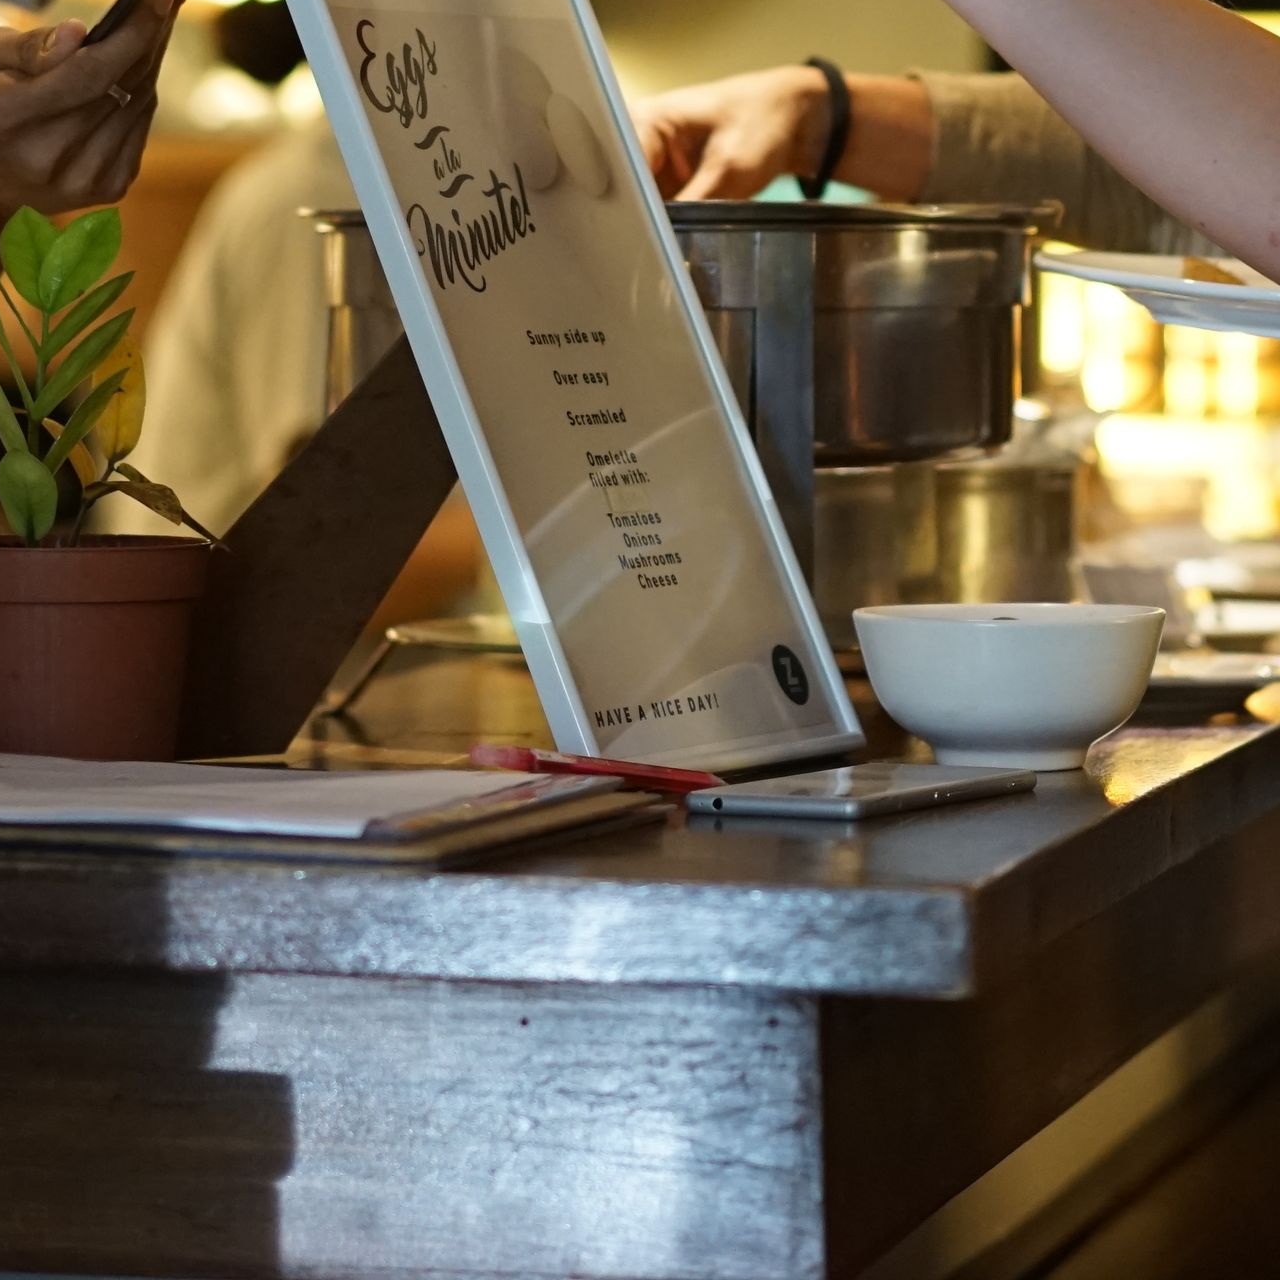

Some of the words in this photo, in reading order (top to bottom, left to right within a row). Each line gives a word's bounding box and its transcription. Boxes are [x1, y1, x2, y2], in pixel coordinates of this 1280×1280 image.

[356, 19, 438, 129] Eggs
[406, 162, 536, 292] Minute!
[526, 330, 561, 348] Sunny
[564, 329, 589, 345] side
[592, 330, 606, 346] up
[553, 370, 578, 386] Over
[582, 371, 610, 386] easy
[566, 408, 627, 427] Scrambled
[586, 450, 638, 466] Omelette
[589, 472, 619, 488] filled
[621, 469, 651, 486] with:
[607, 512, 662, 528] Tomatoes
[623, 532, 662, 548] Onions
[618, 552, 682, 570] Mushrooms
[637, 573, 678, 589] Cheese
[595, 707, 632, 728] HAVE
[638, 705, 647, 721] A
[651, 699, 683, 718] NICE
[688, 692, 719, 713] DAY!
